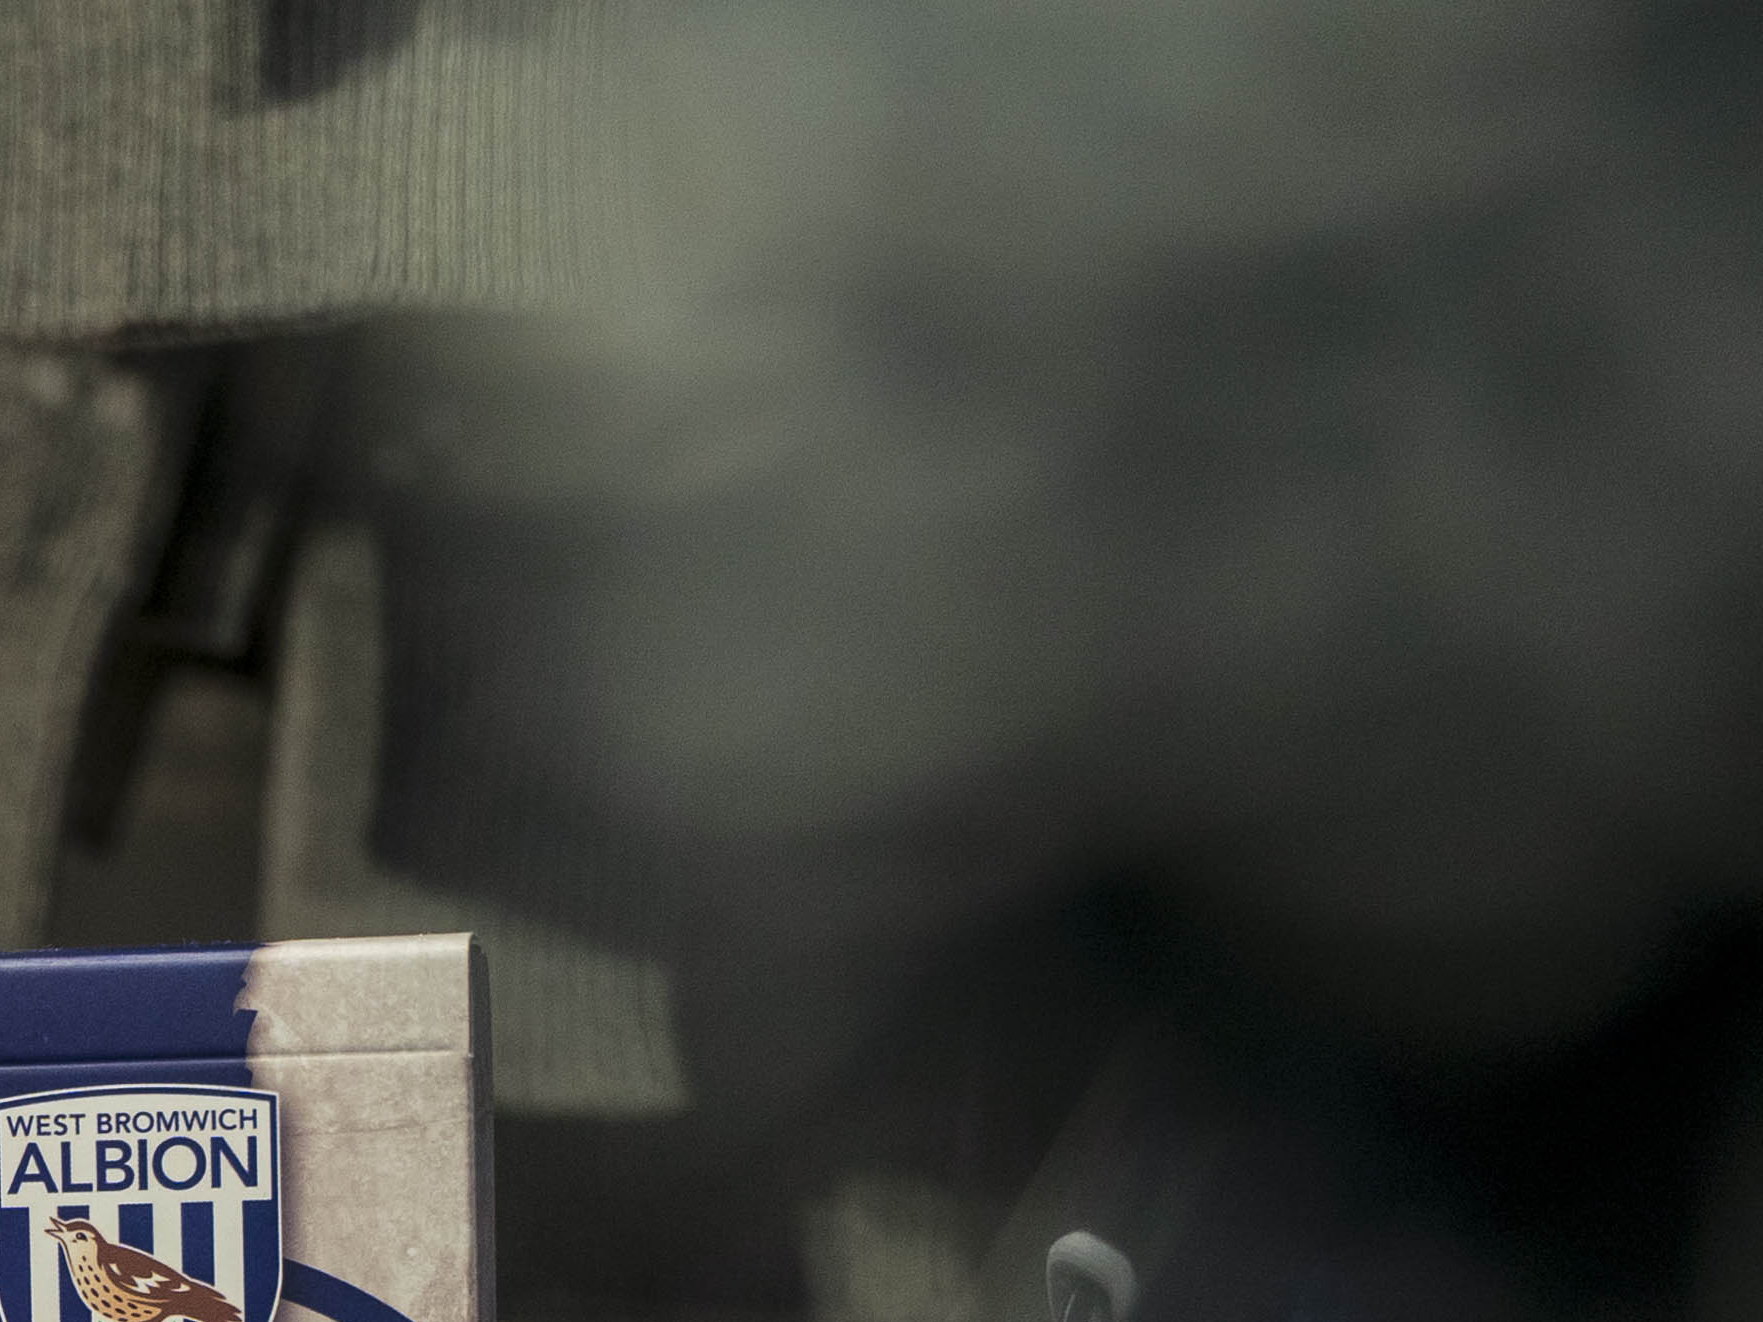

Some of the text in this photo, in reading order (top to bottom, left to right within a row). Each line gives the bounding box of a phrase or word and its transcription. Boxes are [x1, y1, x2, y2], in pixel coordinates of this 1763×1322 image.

[6, 1107, 258, 1138] WEST BROMWICH
[6, 1135, 259, 1195] ALBION
